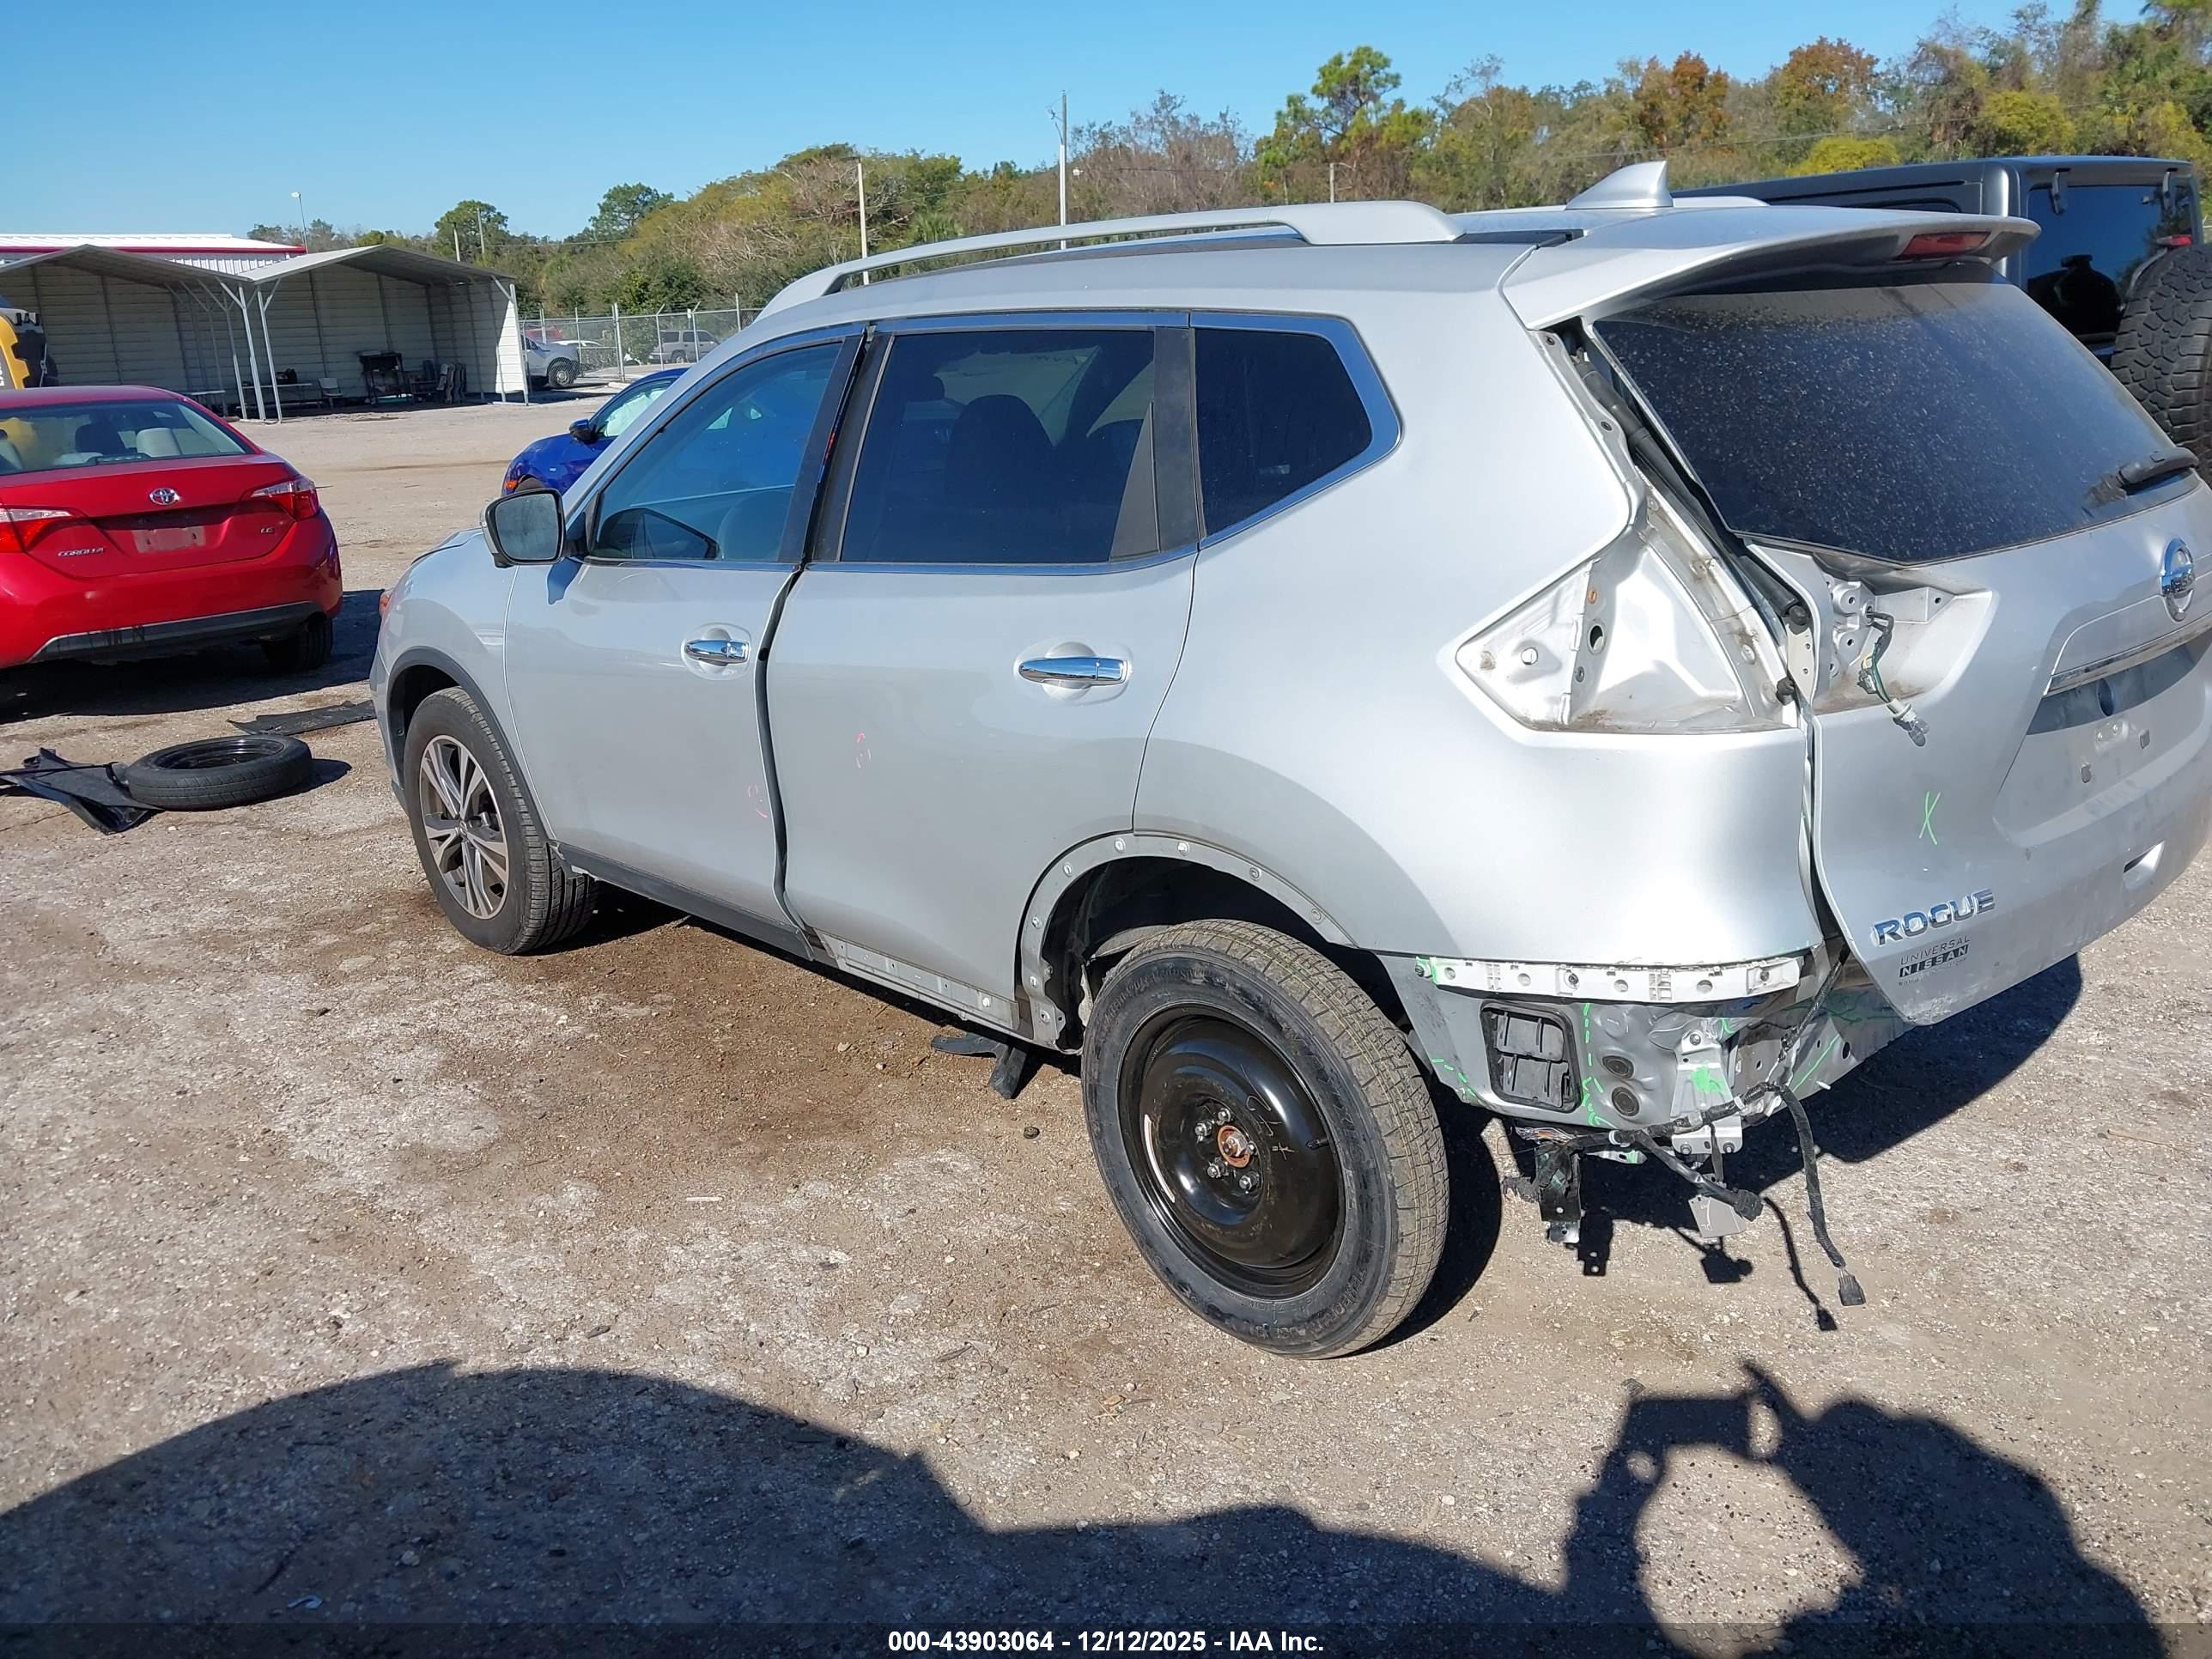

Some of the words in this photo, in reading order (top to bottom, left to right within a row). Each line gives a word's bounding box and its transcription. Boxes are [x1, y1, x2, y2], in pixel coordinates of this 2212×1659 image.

[1871, 887, 1995, 946] ROGUE
[1899, 945, 1968, 977] NISSAN
[1900, 935, 1970, 965] UNIVERSAL
